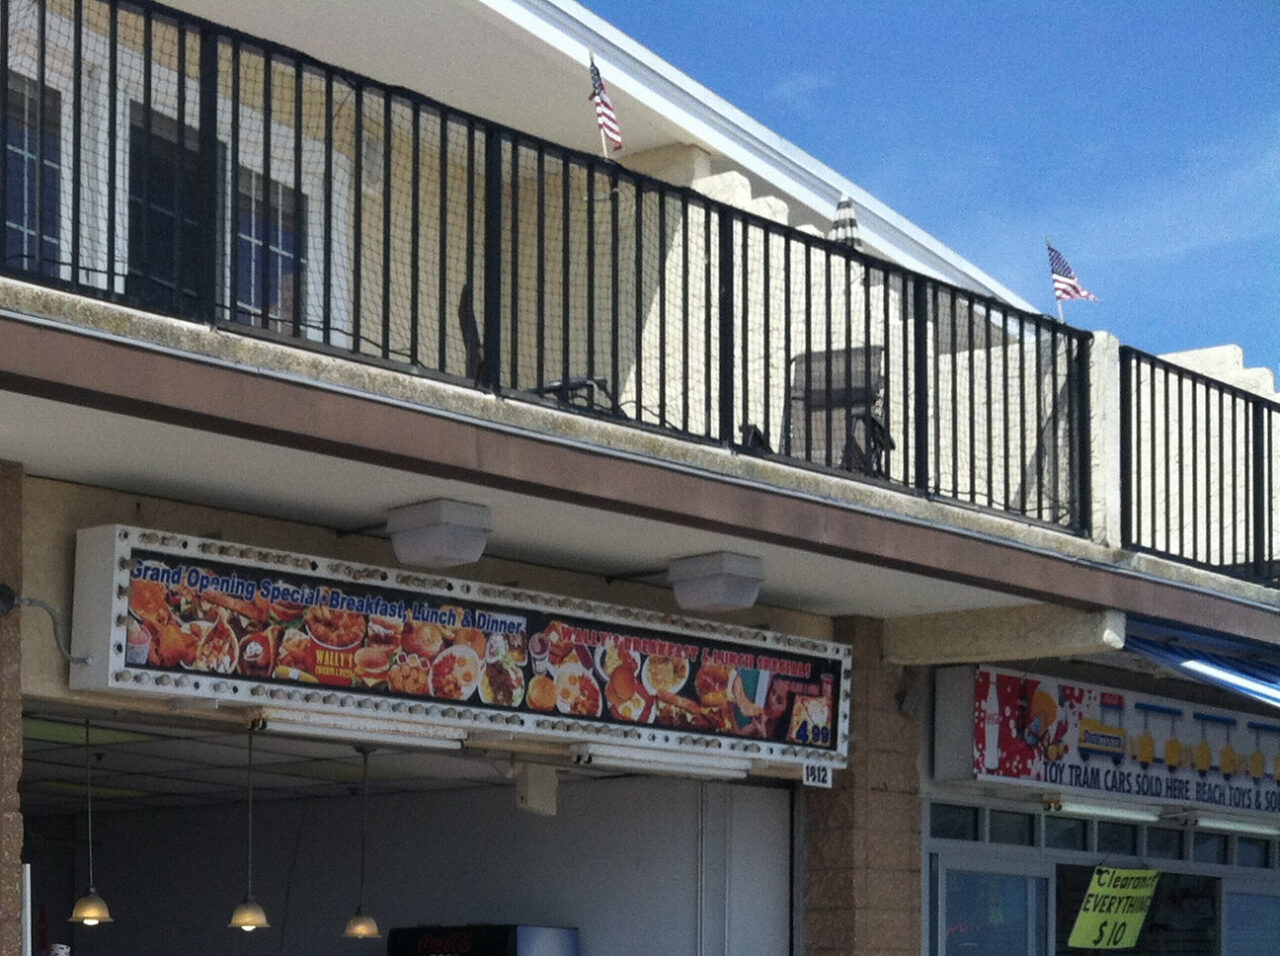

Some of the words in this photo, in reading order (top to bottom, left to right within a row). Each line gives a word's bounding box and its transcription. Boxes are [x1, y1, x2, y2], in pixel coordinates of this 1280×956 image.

[131, 559, 183, 584] Grand
[187, 569, 256, 601] Opening
[329, 590, 408, 622] Breakfast,
[412, 602, 457, 627] Lunch
[461, 611, 472, 628] &
[476, 611, 523, 635] Dinner
[1043, 761, 1066, 784] TOY
[1069, 763, 1101, 790] TRAM
[1104, 769, 1132, 793] CARS
[1135, 774, 1164, 797] SOLD
[1165, 778, 1191, 800] HERE
[1196, 782, 1225, 805] BEACH
[1228, 786, 1252, 809] TOYS
[1082, 894, 1153, 914] EVERYTHIN
[1093, 920, 1127, 946] $10
